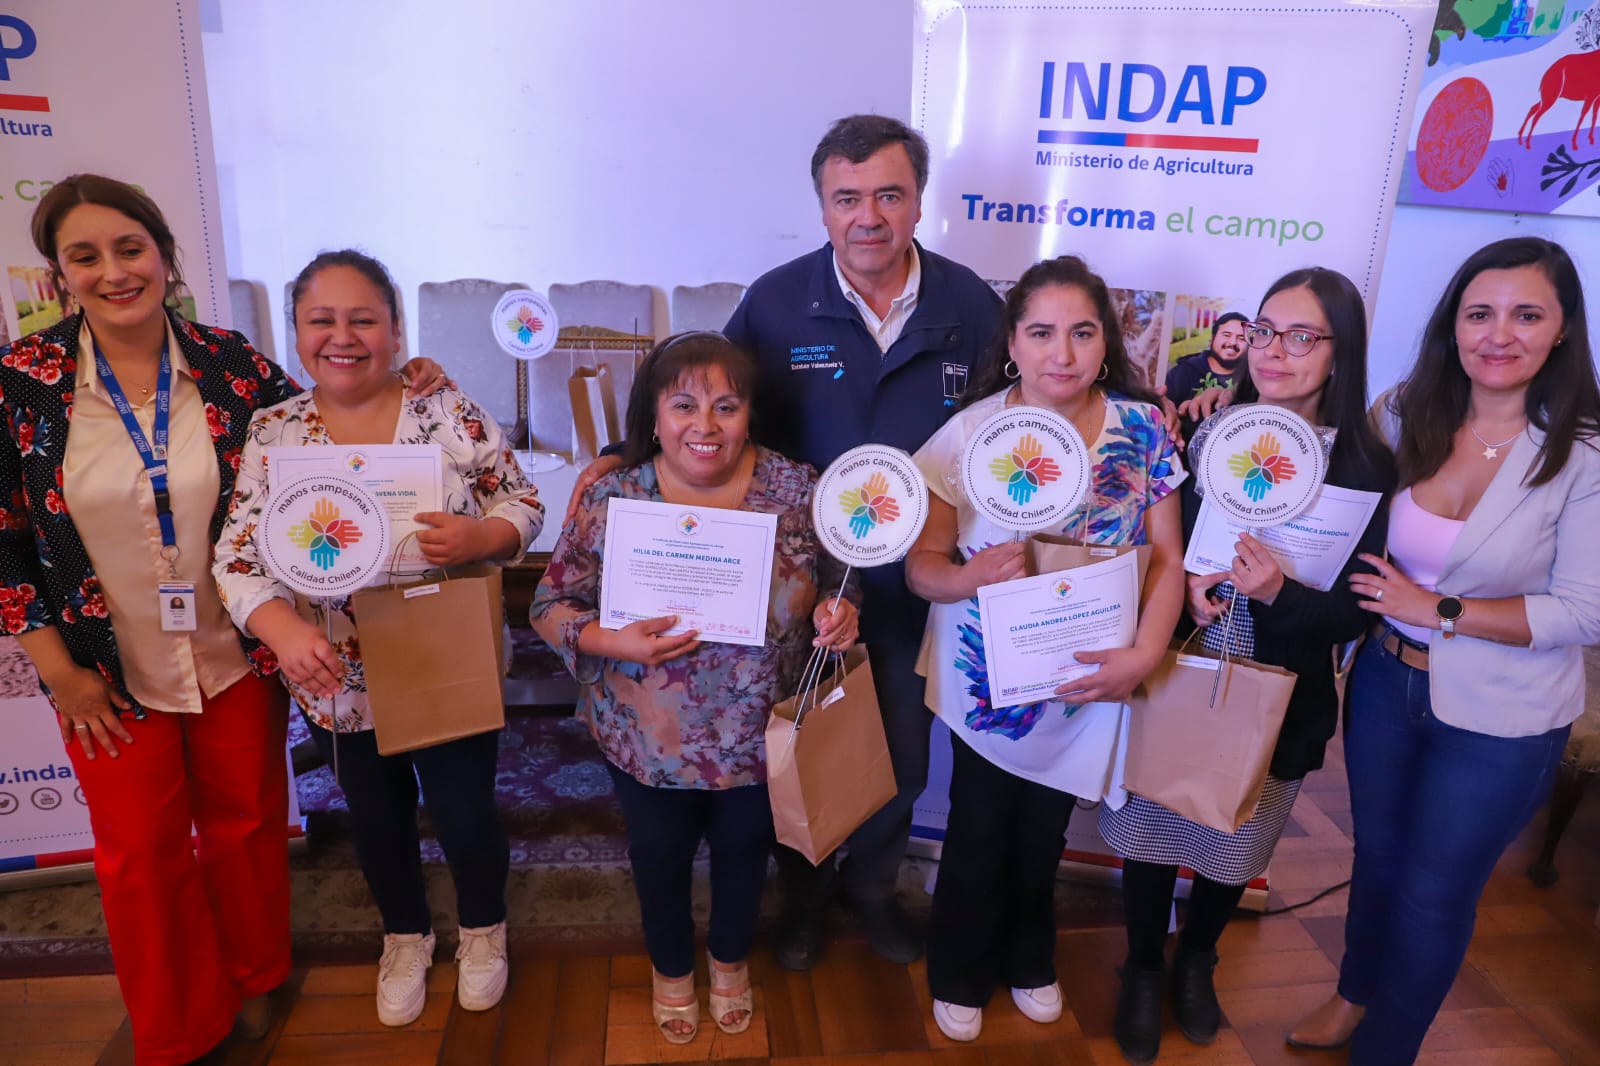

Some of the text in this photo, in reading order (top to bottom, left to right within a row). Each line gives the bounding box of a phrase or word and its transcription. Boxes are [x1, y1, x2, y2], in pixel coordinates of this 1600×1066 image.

[1039, 61, 1267, 126] INDAP
[1035, 150, 1254, 177] Ministerio de Agricultura
[961, 193, 1325, 246] Transforma el campo
[983, 420, 1073, 455] manos campesinas
[1224, 418, 1309, 455] manos campesinas
[839, 458, 915, 498] manos campesinas
[277, 487, 309, 514] manos
[311, 484, 371, 515] campesinas
[987, 497, 1055, 519] Calidad Chilena
[1222, 491, 1288, 516] Calidad Chilena
[829, 526, 887, 554] Calidad Chilena
[651, 549, 665, 557] DEL
[665, 551, 694, 560] CARMEN
[695, 554, 722, 563] MEDINA
[723, 556, 741, 565] ARCE
[290, 565, 362, 584] Calidad Chilena
[1009, 621, 1040, 632] CLAUDIA
[1040, 616, 1068, 626] ANDREA
[1090, 603, 1121, 617] AGUILERA
